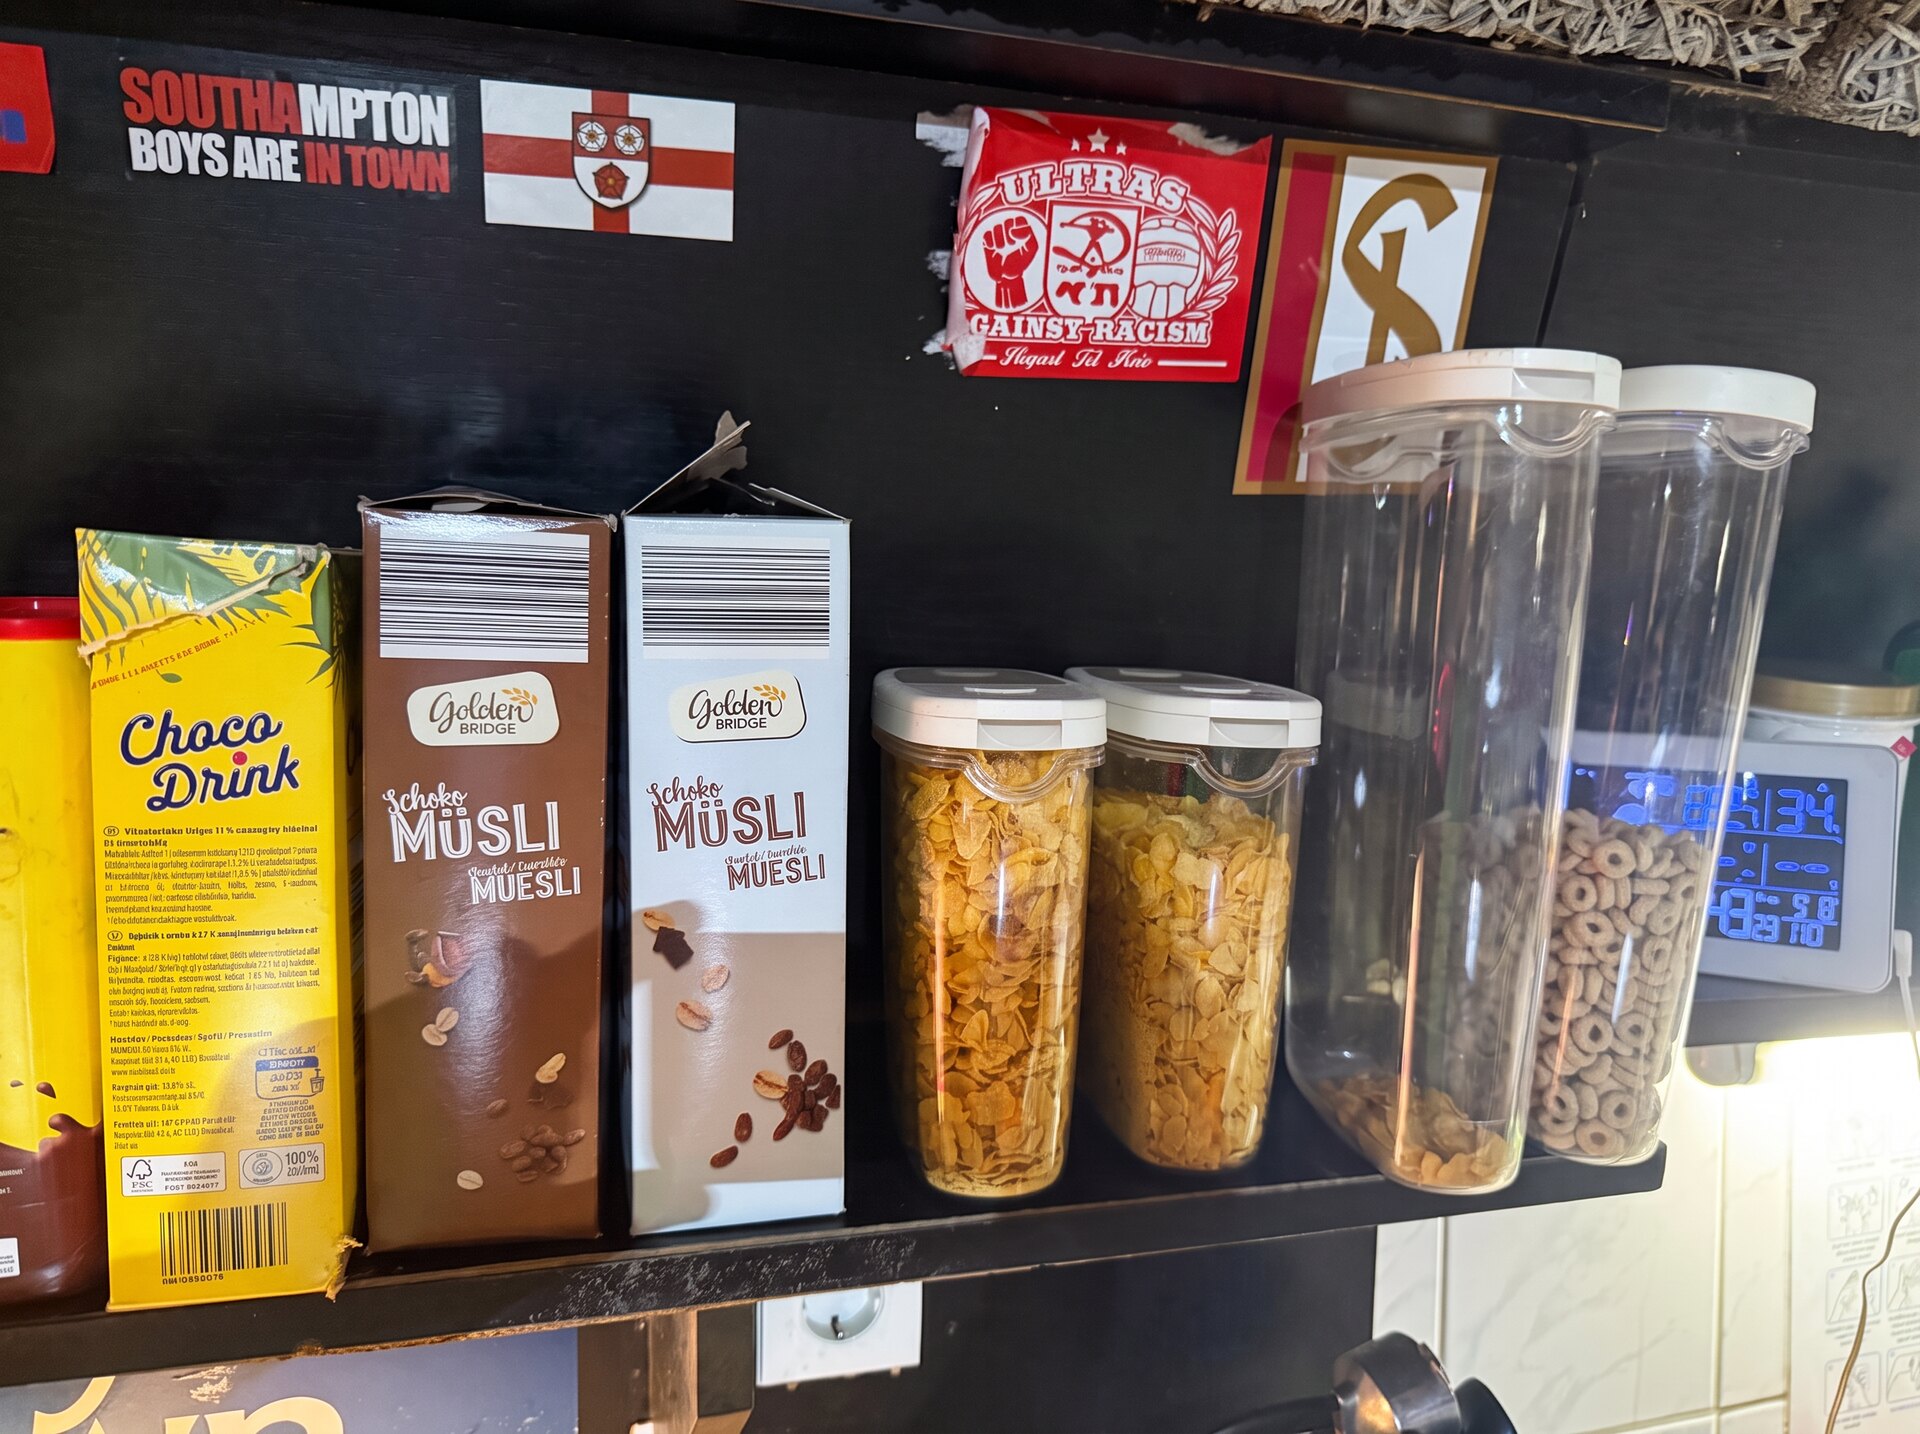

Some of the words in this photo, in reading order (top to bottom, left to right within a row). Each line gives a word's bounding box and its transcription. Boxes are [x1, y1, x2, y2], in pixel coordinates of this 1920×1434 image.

[120, 67, 450, 147] SOUTHAMPTON
[128, 127, 228, 177] BOYS
[233, 135, 301, 182] ARE
[303, 142, 342, 185] IN
[344, 145, 450, 193] TOWN
[1000, 161, 1188, 212] ULTRAS
[429, 691, 534, 734] Golden
[459, 722, 517, 735] BRIDGE
[688, 689, 783, 730] Golden
[715, 717, 767, 730] BRIDGE
[120, 709, 284, 766] Choco
[146, 743, 300, 812] Drink
[382, 782, 468, 815] Schoko
[645, 775, 724, 808] Schoko
[389, 801, 561, 863] MÜSLI
[653, 791, 807, 853] MÜSLI
[470, 866, 582, 905] MUESLI
[726, 854, 826, 891] MUESLI
[285, 1150, 319, 1167] 100%
